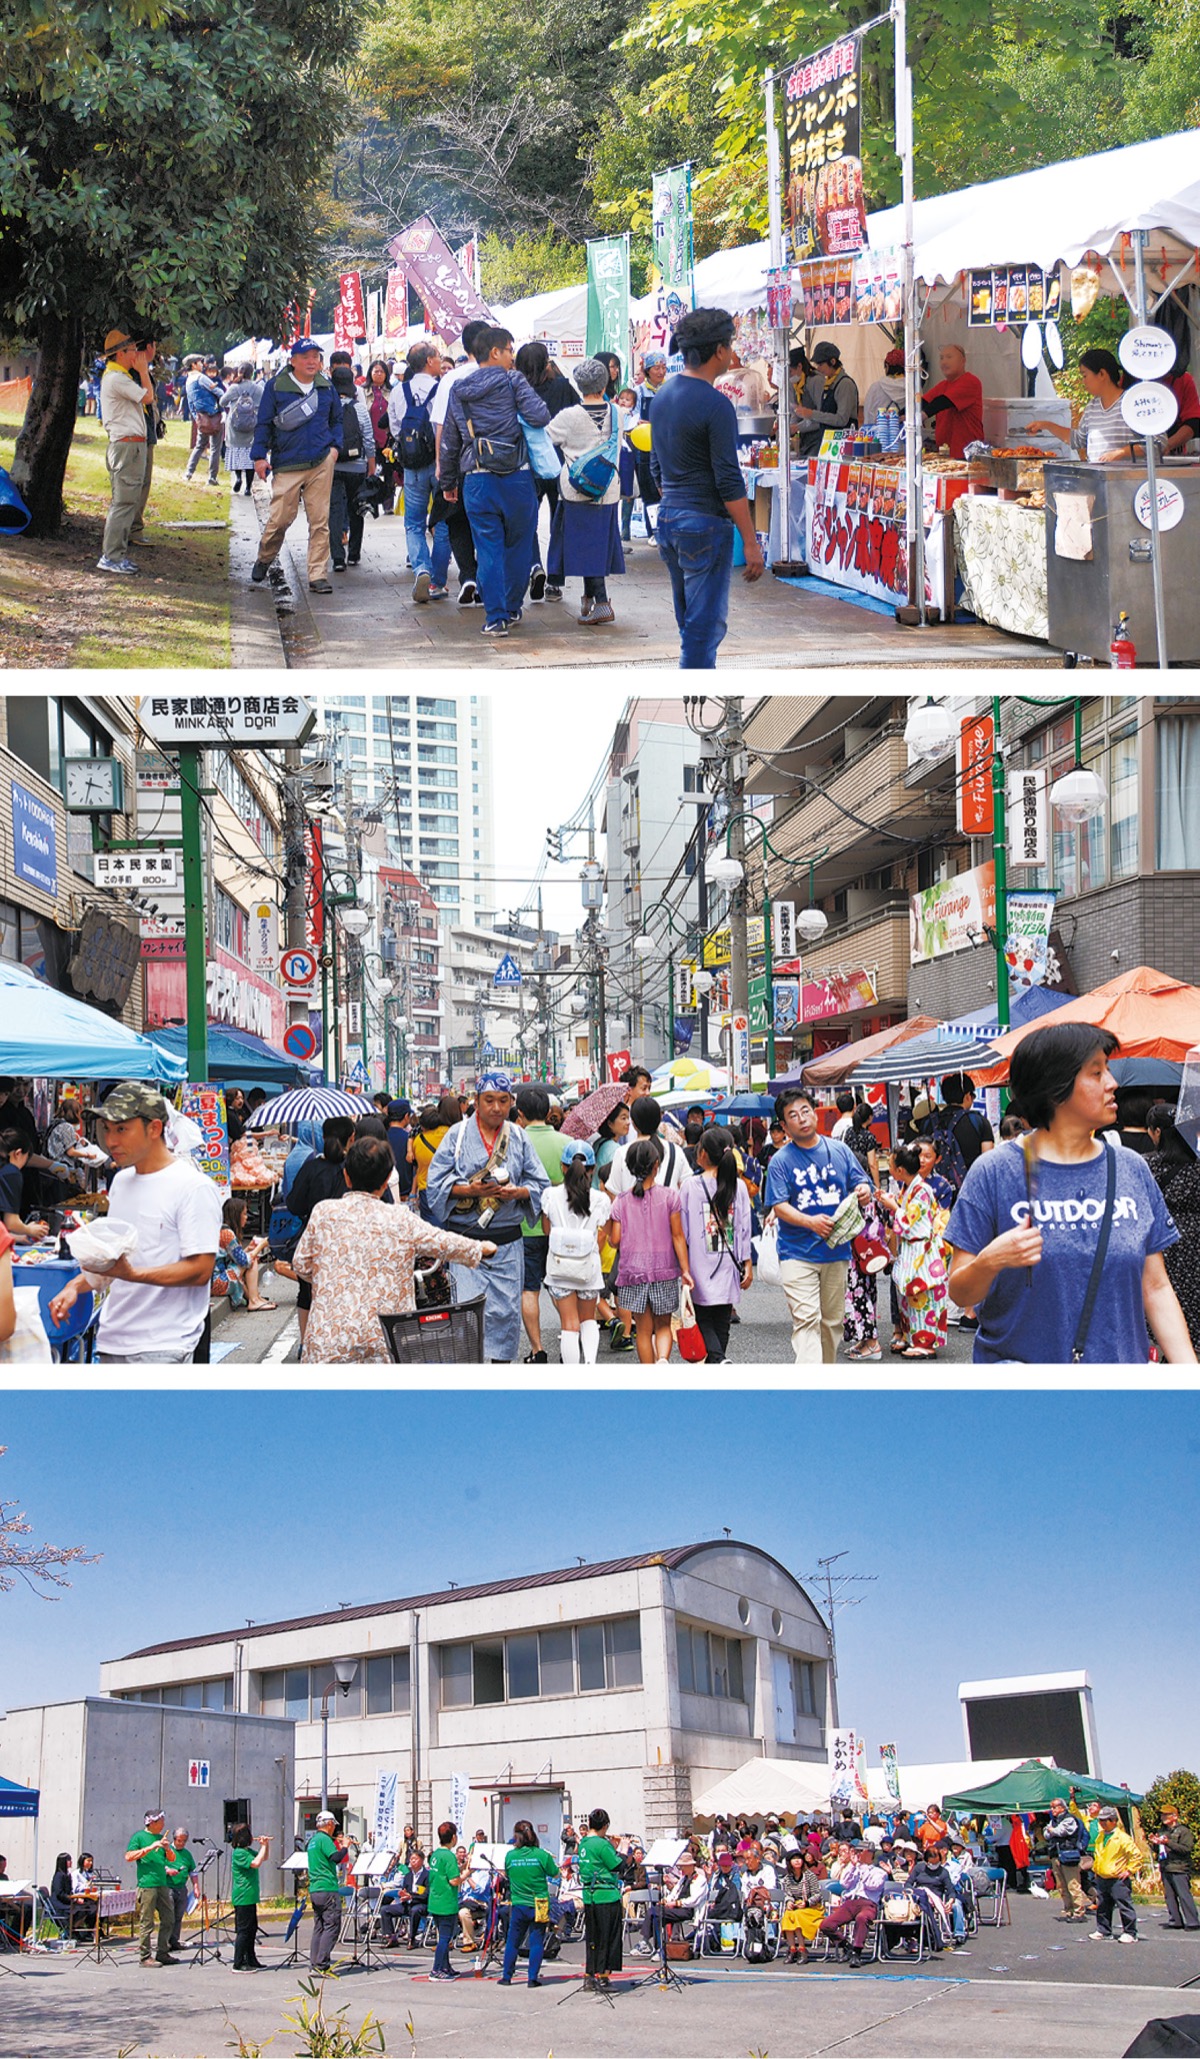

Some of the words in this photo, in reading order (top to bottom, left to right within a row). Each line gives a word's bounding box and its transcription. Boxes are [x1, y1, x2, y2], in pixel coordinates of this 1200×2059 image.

[786, 71, 859, 140] ジャンボ
[789, 121, 848, 175] 串焼き
[723, 382, 745, 399] Candy
[151, 696, 299, 716] 民家園通り商店会
[175, 716, 234, 729] MINKAEN
[1022, 775, 1038, 858] 民家園通り商店会
[98, 858, 173, 871] 日本民家園
[104, 875, 132, 884] この手前
[199, 1092, 226, 1158] 夏まつり
[834, 1736, 848, 1771] わかめ
